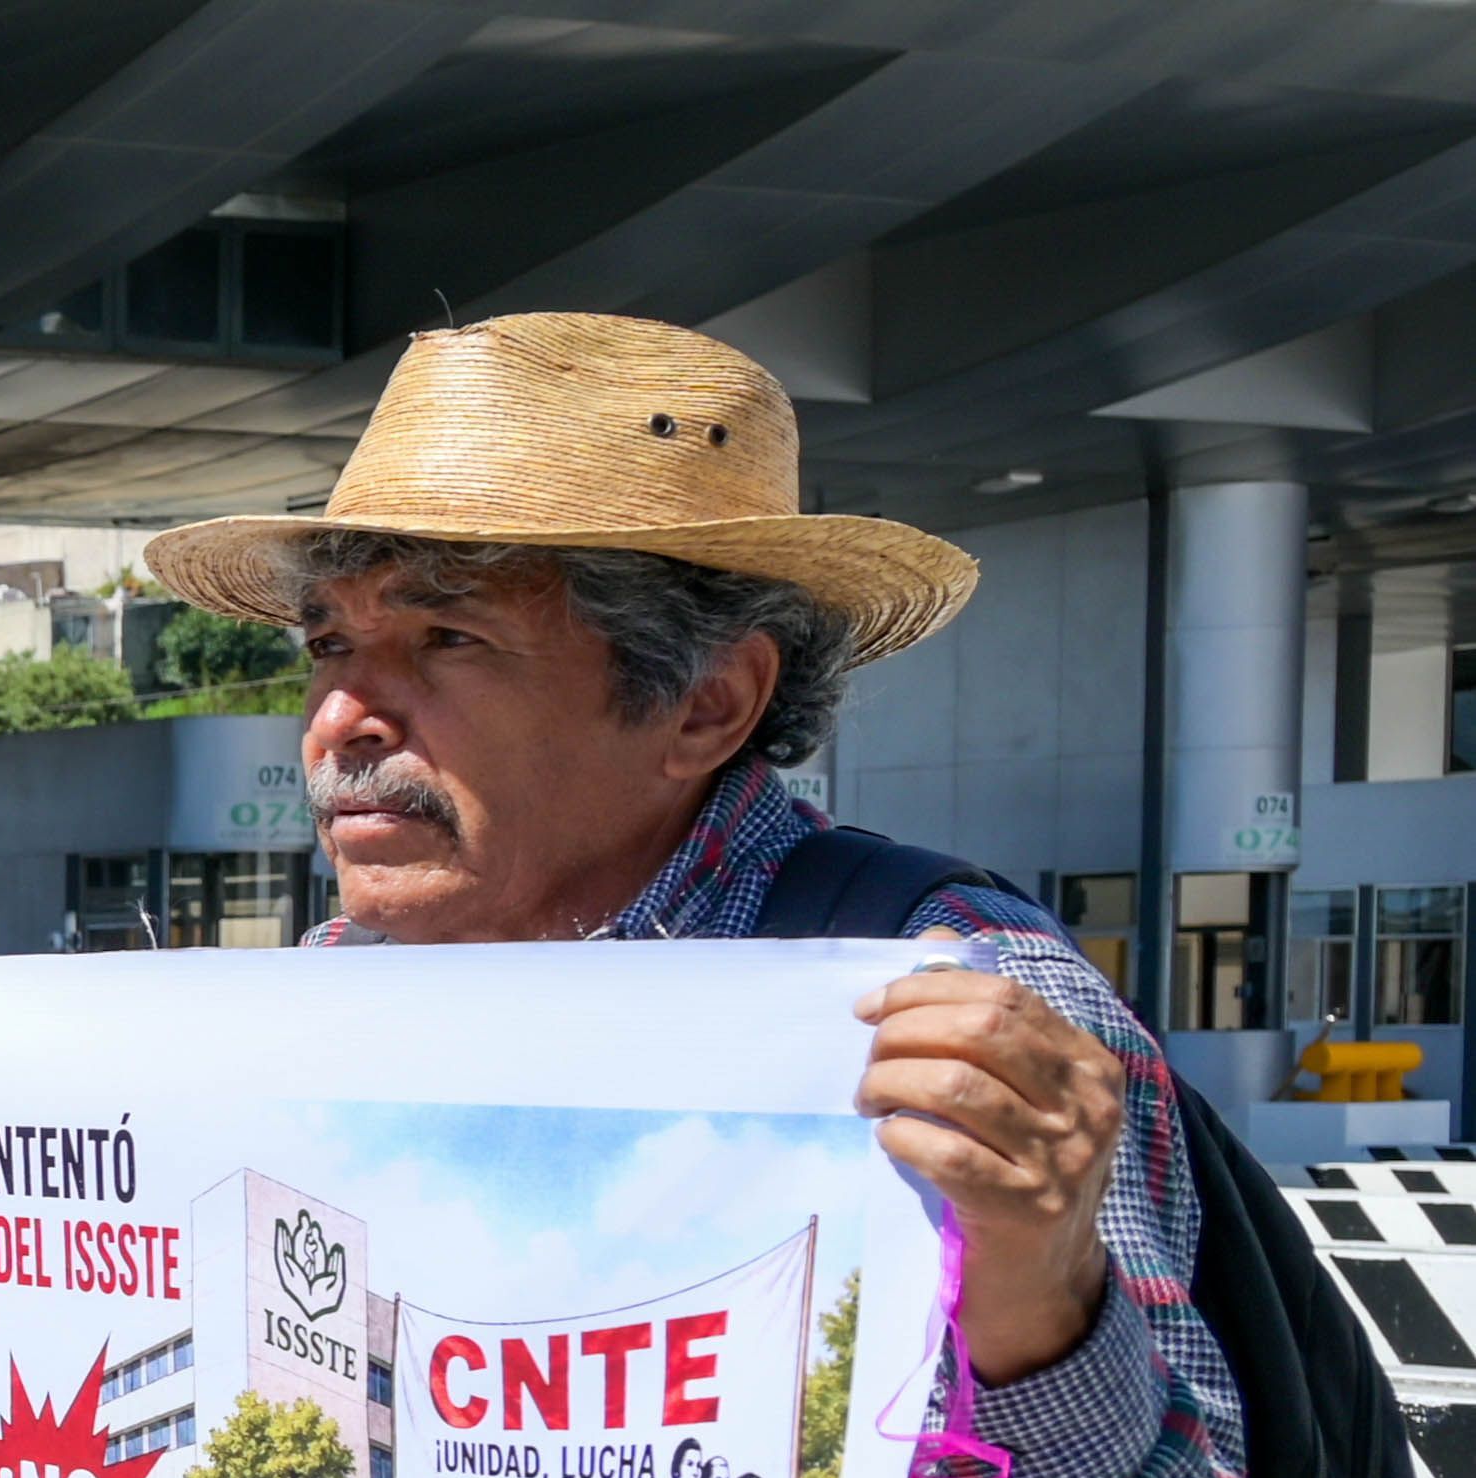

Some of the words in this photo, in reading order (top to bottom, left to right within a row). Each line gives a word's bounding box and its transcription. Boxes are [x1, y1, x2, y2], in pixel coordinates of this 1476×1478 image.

[259, 766, 296, 786] 074
[788, 780, 821, 797] 074
[1257, 796, 1288, 816] 074
[64, 1220, 181, 1300] ISSSTE
[263, 1308, 358, 1381] ISSSTE
[428, 1309, 729, 1431] CNTE
